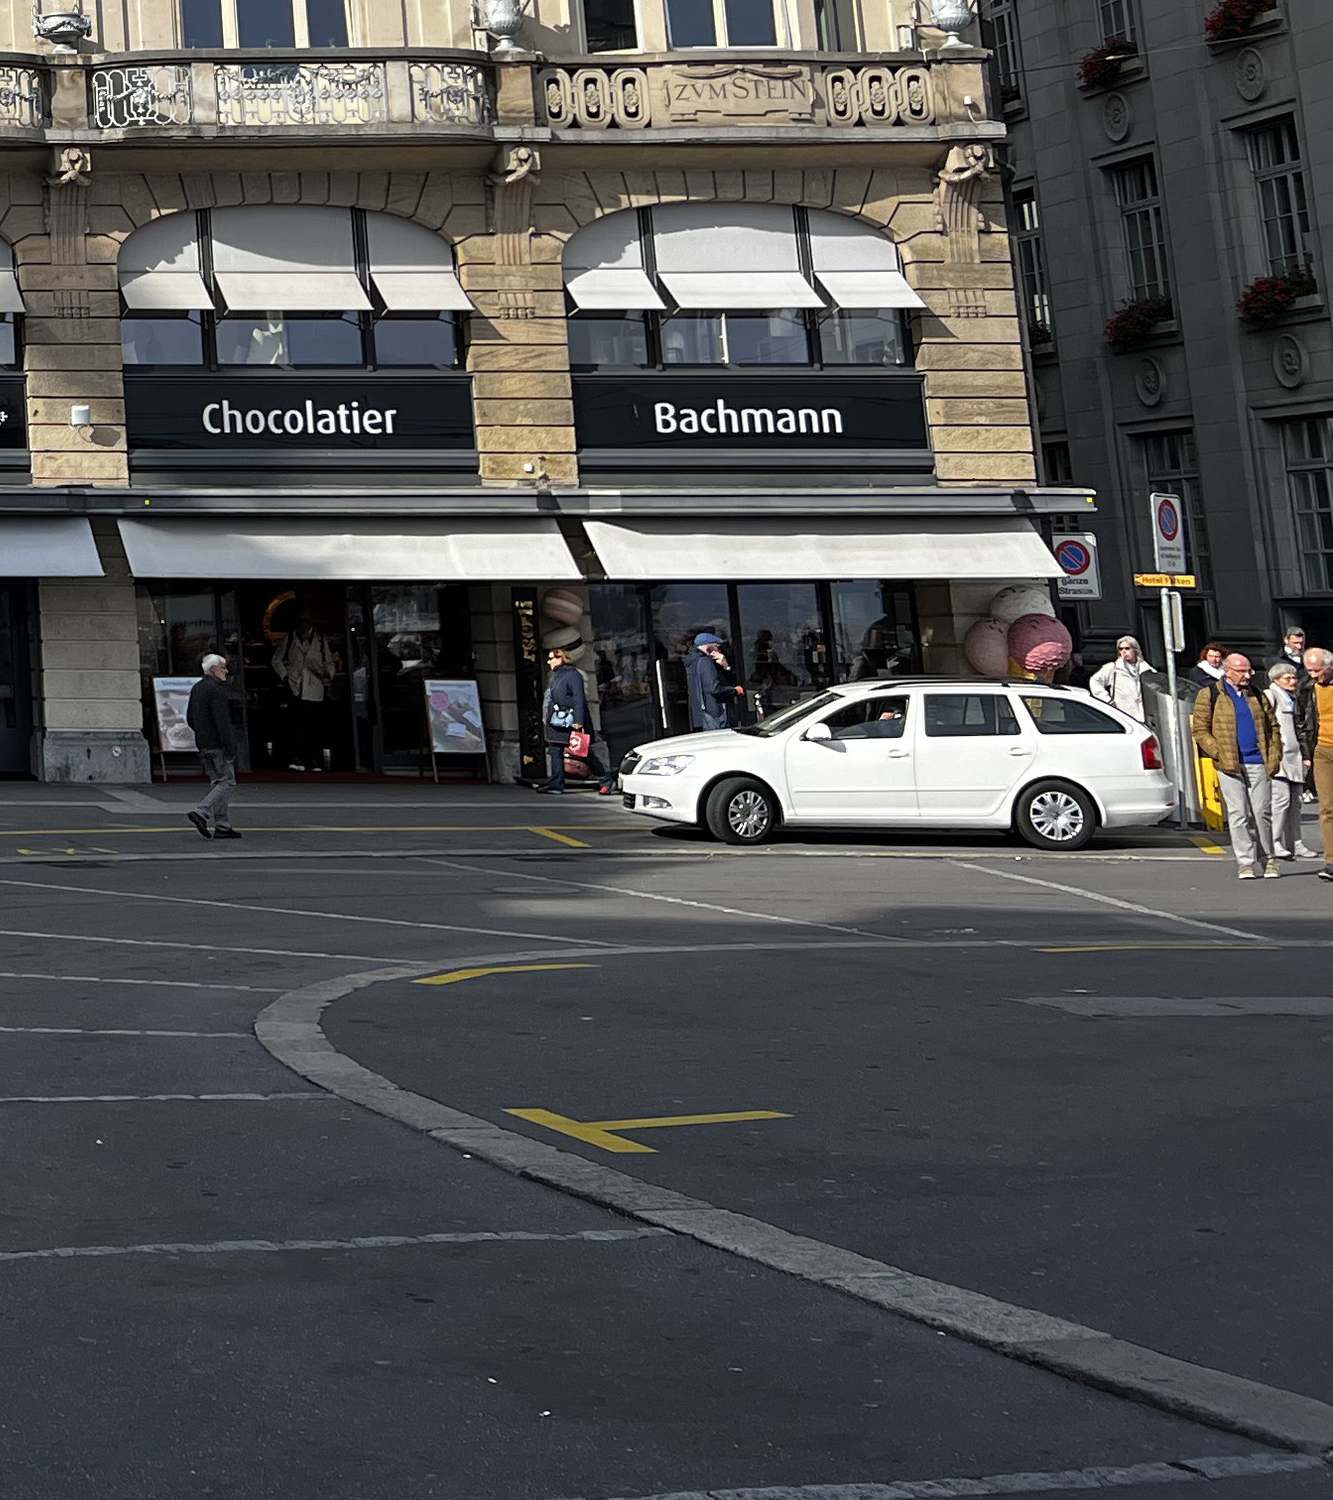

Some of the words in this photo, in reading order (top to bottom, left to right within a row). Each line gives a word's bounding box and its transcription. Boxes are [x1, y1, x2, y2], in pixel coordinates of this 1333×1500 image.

[733, 76, 808, 100] STEIN
[201, 400, 397, 436] Chocolatier
[654, 399, 843, 434] Bachmann
